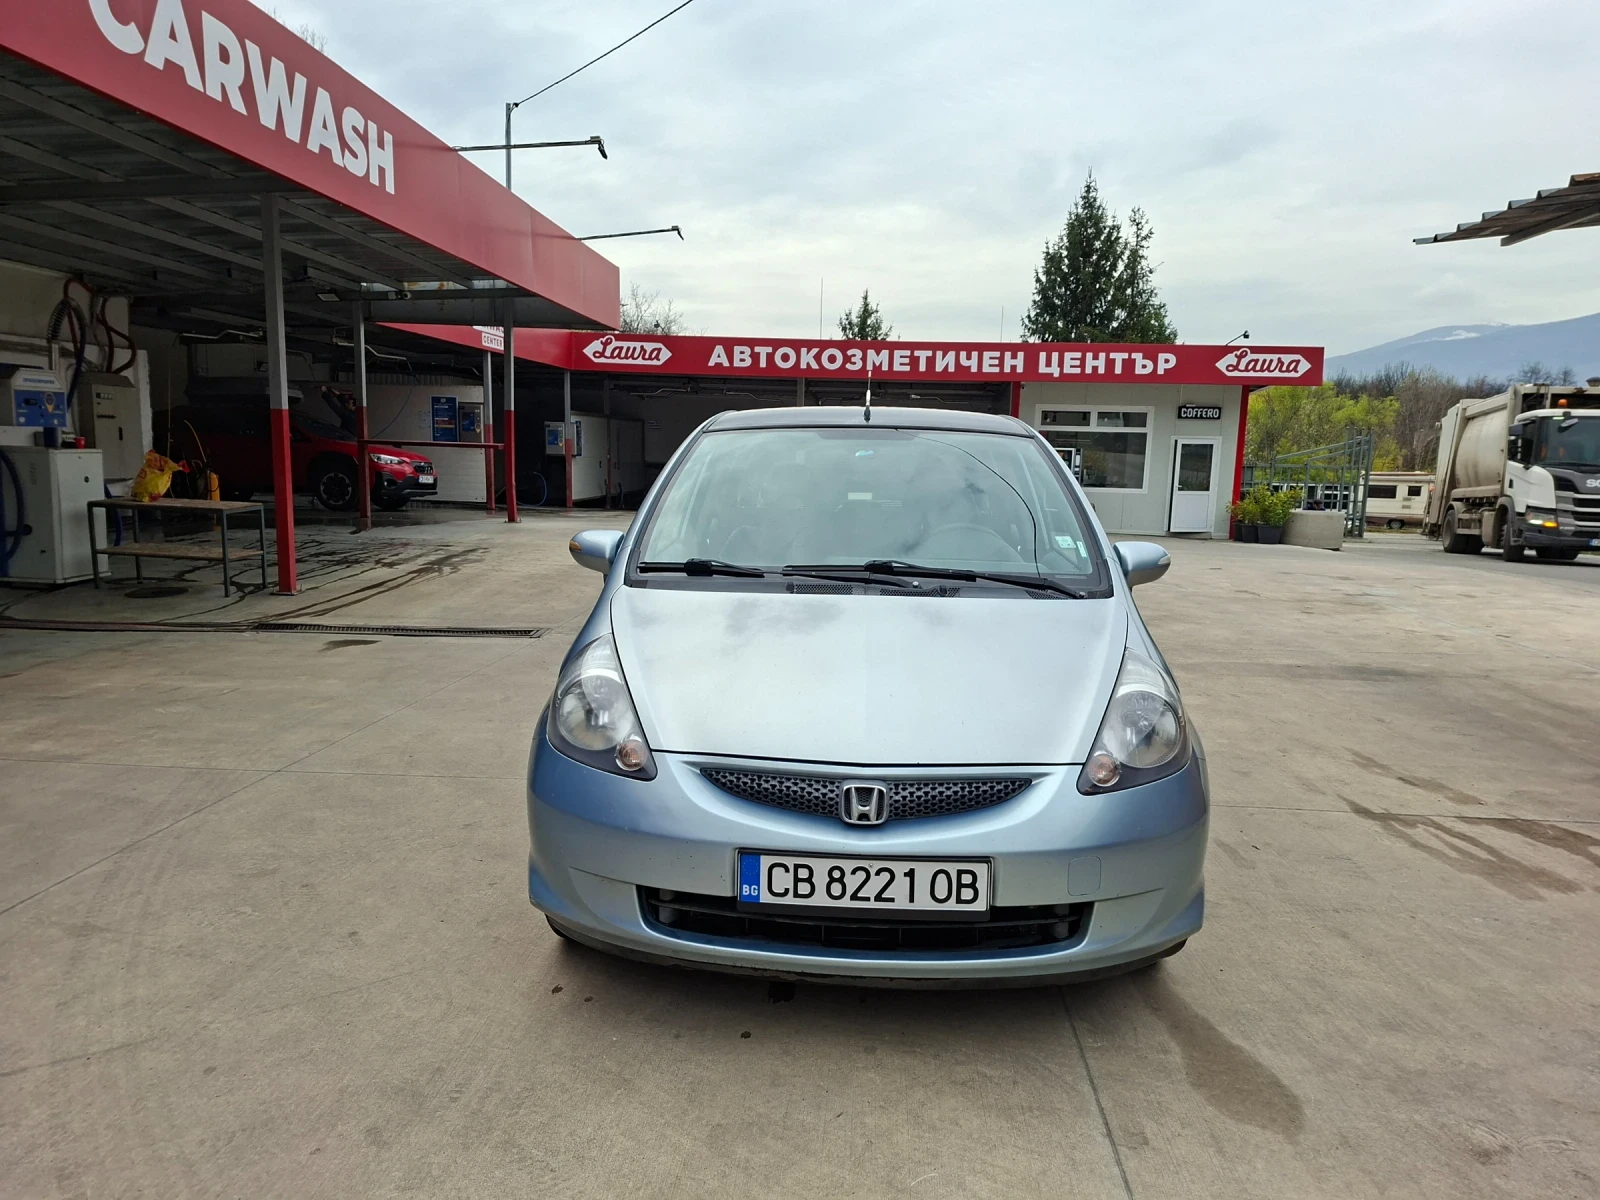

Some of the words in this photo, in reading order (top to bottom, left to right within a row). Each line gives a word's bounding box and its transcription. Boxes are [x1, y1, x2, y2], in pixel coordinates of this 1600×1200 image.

[592, 337, 662, 361] Laura
[708, 345, 1024, 373] АВТОКОЗМЕТИЧЕН
[1038, 351, 1177, 377] ЦЕНТЪР
[1225, 349, 1301, 374] Laura
[1181, 408, 1220, 418] COFFERO
[742, 885, 758, 896] BG
[767, 862, 816, 899] CB
[825, 865, 915, 904] 8221
[929, 868, 979, 905] OB
